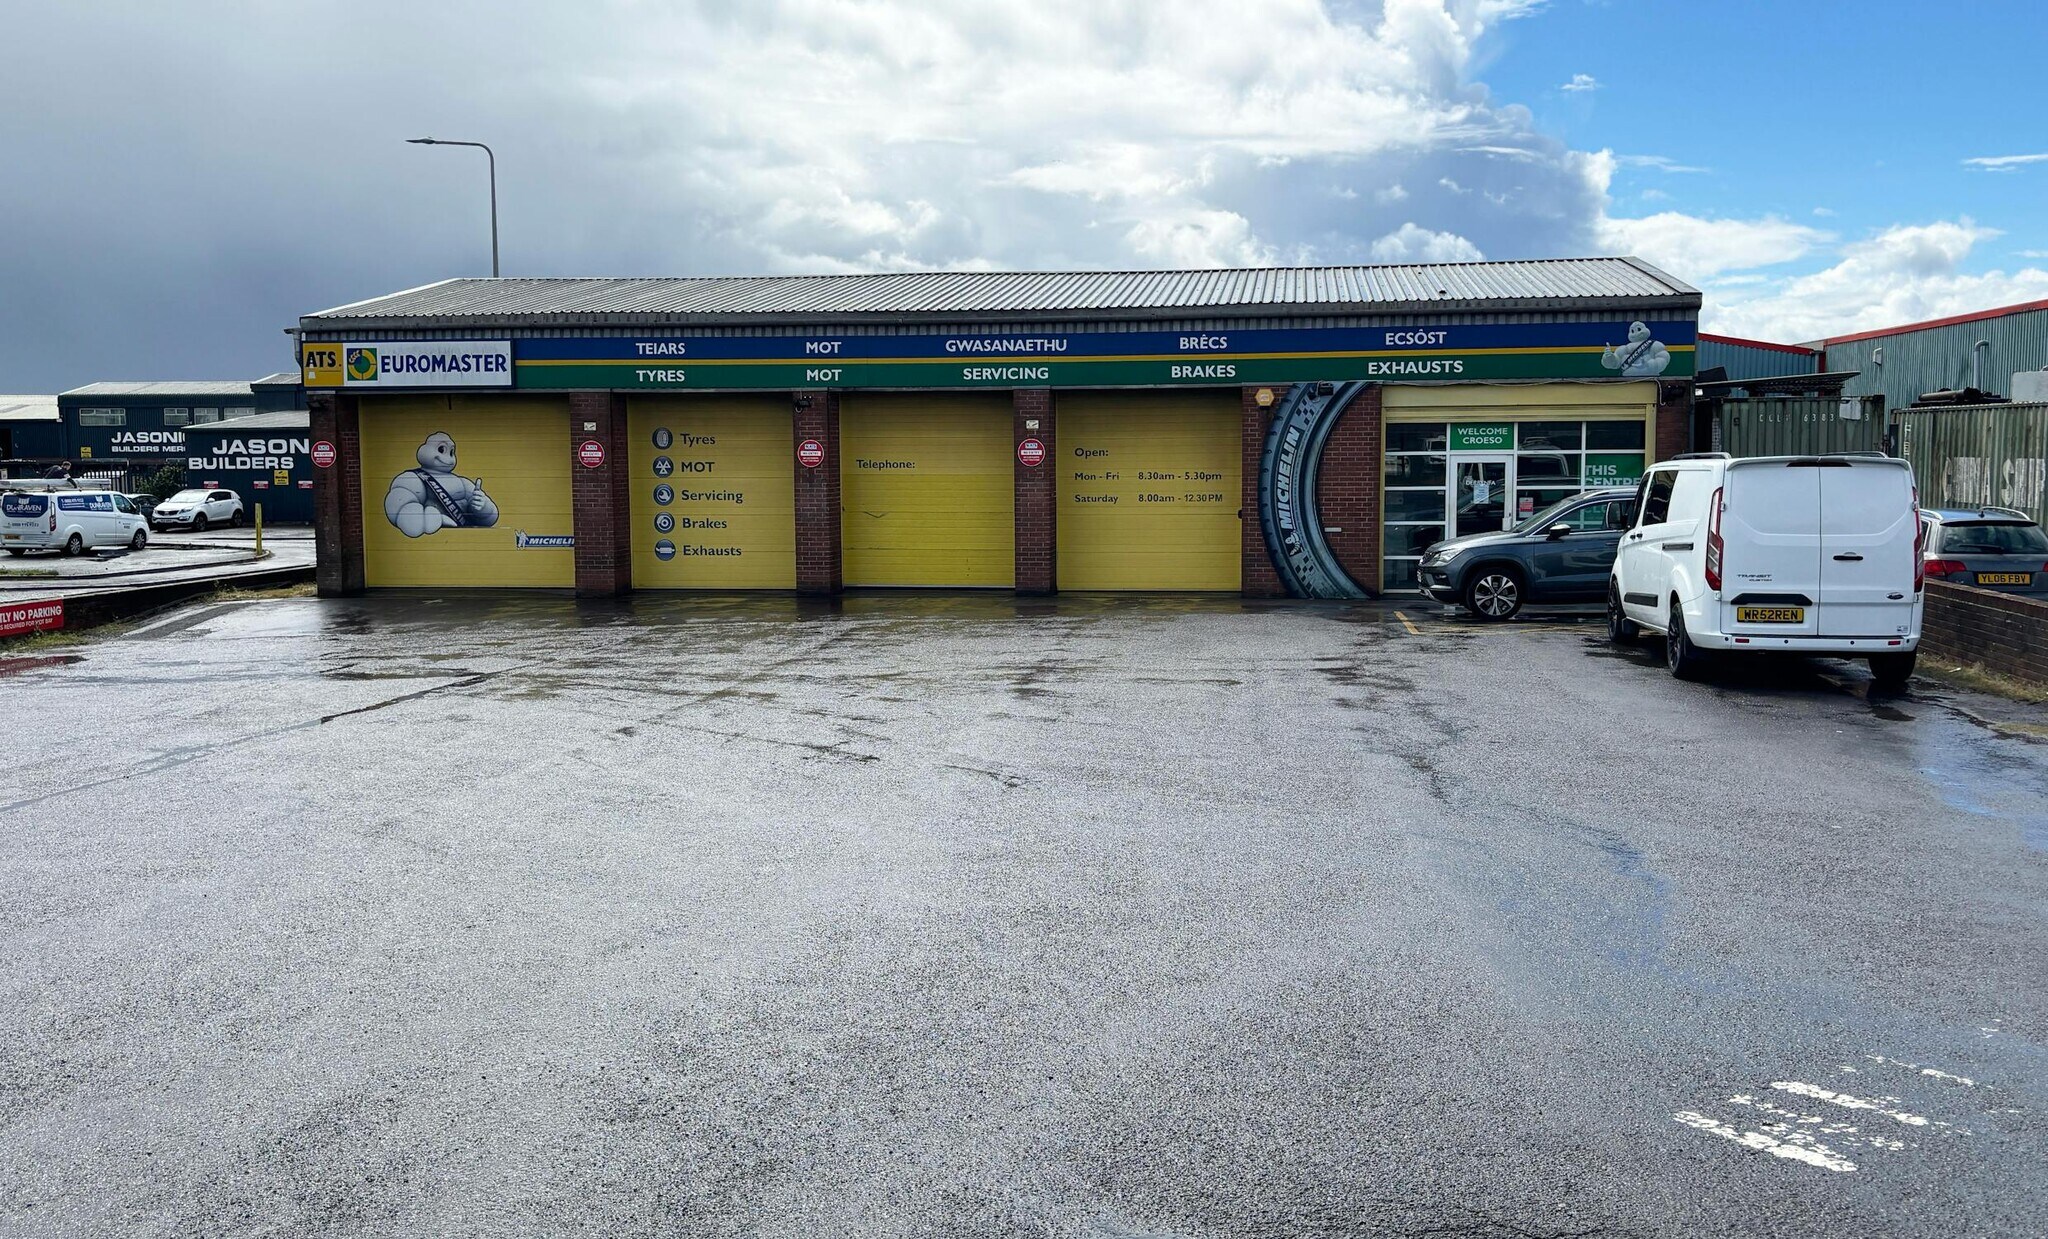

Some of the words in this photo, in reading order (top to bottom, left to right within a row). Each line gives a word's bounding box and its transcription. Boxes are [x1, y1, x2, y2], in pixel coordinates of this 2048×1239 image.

[1179, 333, 1228, 350] BRÊCS
[1385, 328, 1448, 346] ECSÔST
[635, 342, 686, 355] TEIARS
[805, 341, 842, 354] MOT
[945, 338, 1068, 352] GWASANAETHU
[381, 353, 508, 374] EUROMASTER
[1368, 360, 1464, 375] EXHAUSTS
[635, 370, 685, 383] TYRES
[805, 369, 842, 381] MOT
[962, 367, 1049, 380] SERVICING
[1171, 364, 1236, 378] BRAKES
[1457, 427, 1508, 436] WELCOME
[680, 433, 716, 448] Tyres
[1462, 436, 1503, 445] CROESO
[111, 445, 160, 453] BUILDERS
[1074, 447, 1109, 459] Open:
[188, 457, 295, 470] BUILDERS
[681, 461, 715, 473] MOT
[856, 459, 916, 470] Telephone:
[1585, 465, 1617, 475] THIS
[1074, 472, 1096, 481] Mon
[1105, 471, 1120, 480] Fri
[1138, 471, 1175, 480] 8.30am
[1184, 471, 1222, 483] 5.30pm
[1277, 426, 1300, 530] MICHELIN
[681, 489, 744, 504] Servicing
[1074, 493, 1119, 504] Saturday
[1138, 493, 1175, 502] 8.00am
[682, 517, 728, 529] Brakes
[683, 544, 742, 556] Exhausts
[1981, 574, 2006, 583] YL06
[2008, 574, 2026, 583] FBV
[13, 610, 26, 621] NO
[28, 605, 62, 619] PARKING
[1744, 610, 1798, 620] WR52REN
